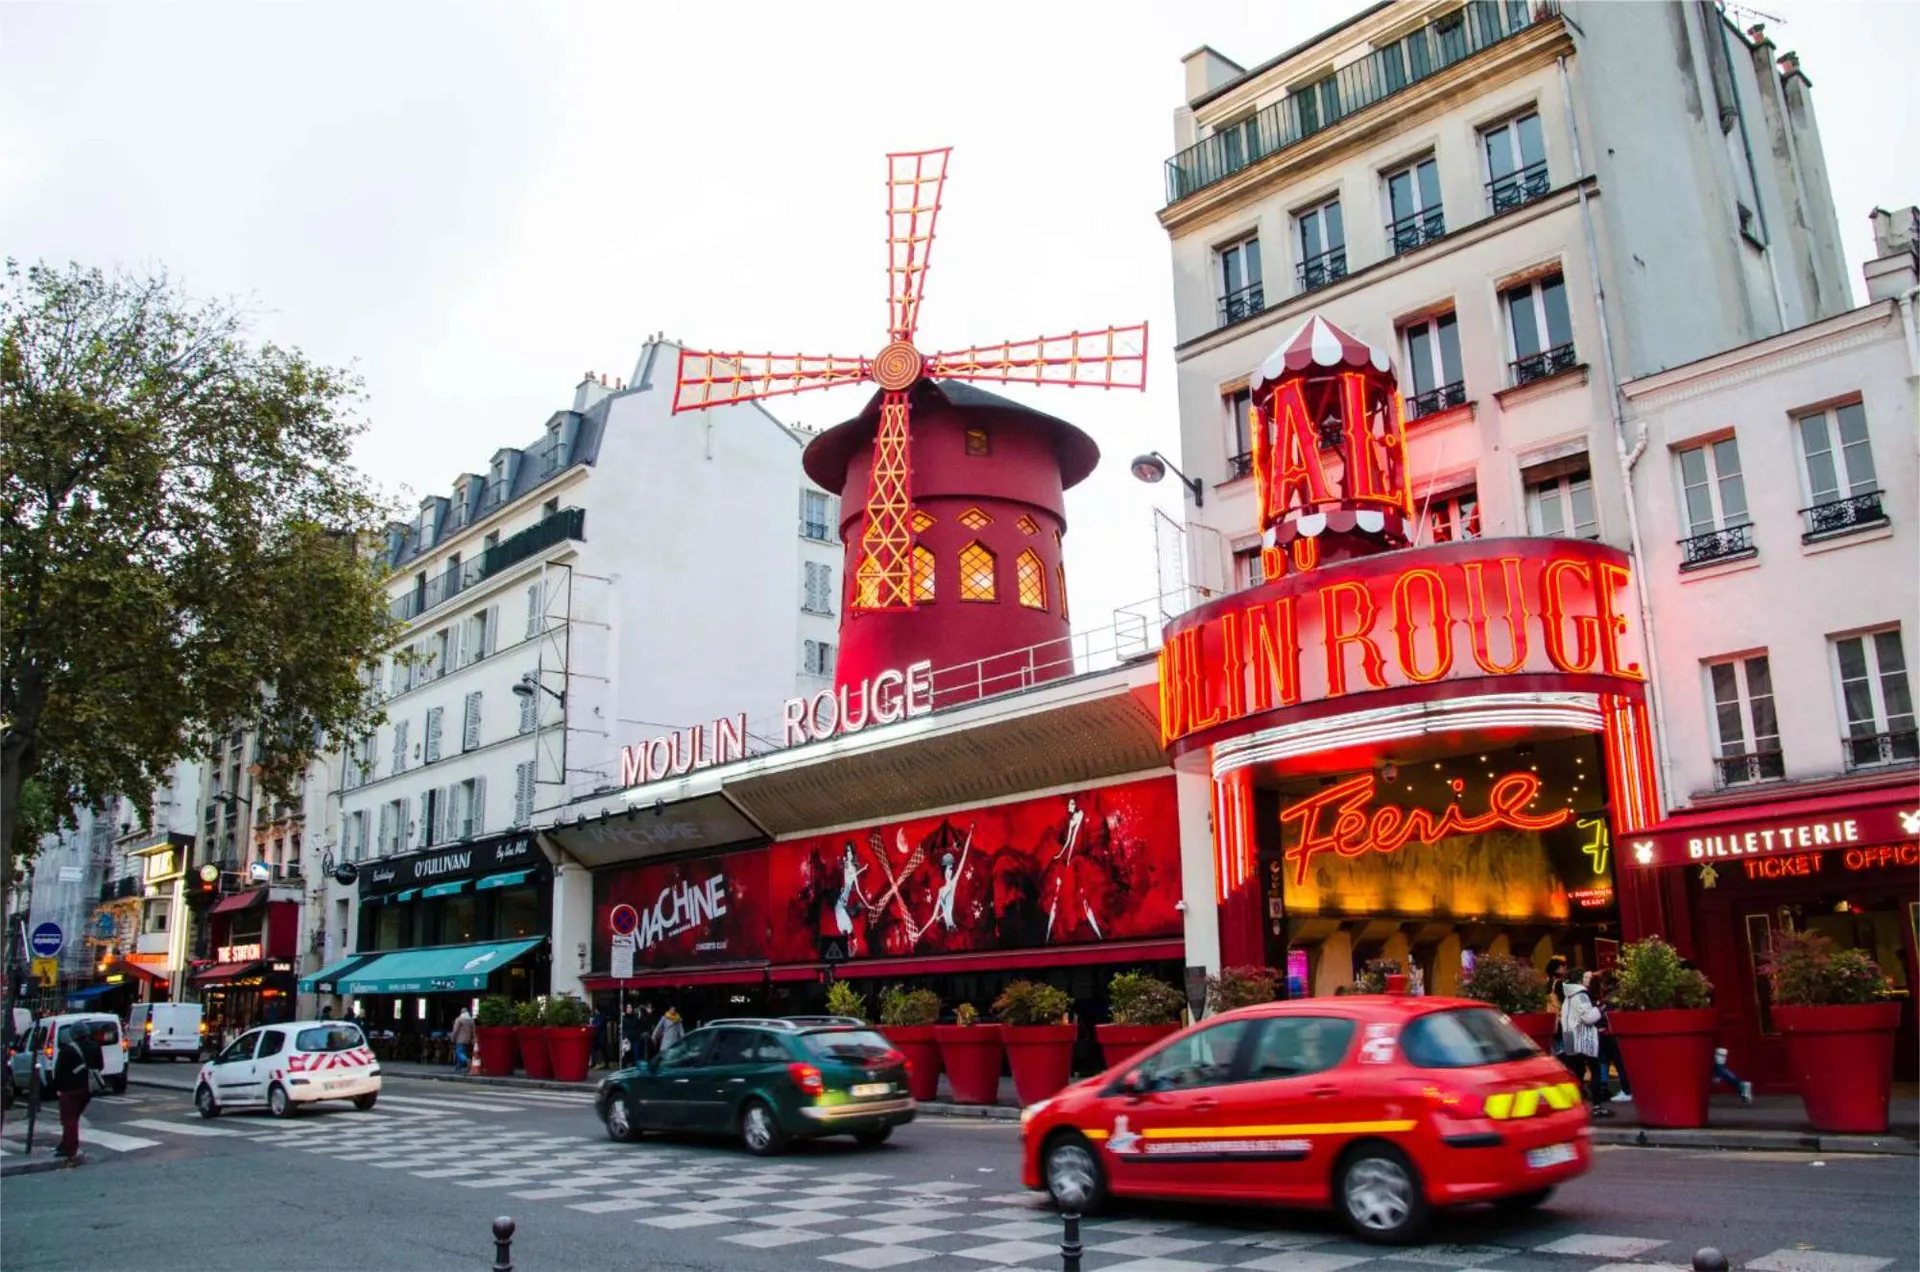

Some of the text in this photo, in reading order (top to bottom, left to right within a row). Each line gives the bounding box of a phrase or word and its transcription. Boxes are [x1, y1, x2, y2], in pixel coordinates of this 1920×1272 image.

[1261, 537, 1317, 581] DU
[1158, 556, 1644, 748] ULIN ROUGE
[620, 660, 933, 787] MOULIN ROUGE
[1280, 774, 1569, 886] Féerie
[1688, 819, 1859, 859] BILLETTERIE
[414, 851, 473, 878] O'SULLIVANS
[1744, 843, 1920, 880] TICKET OFFIC
[634, 874, 727, 950] MACHINE
